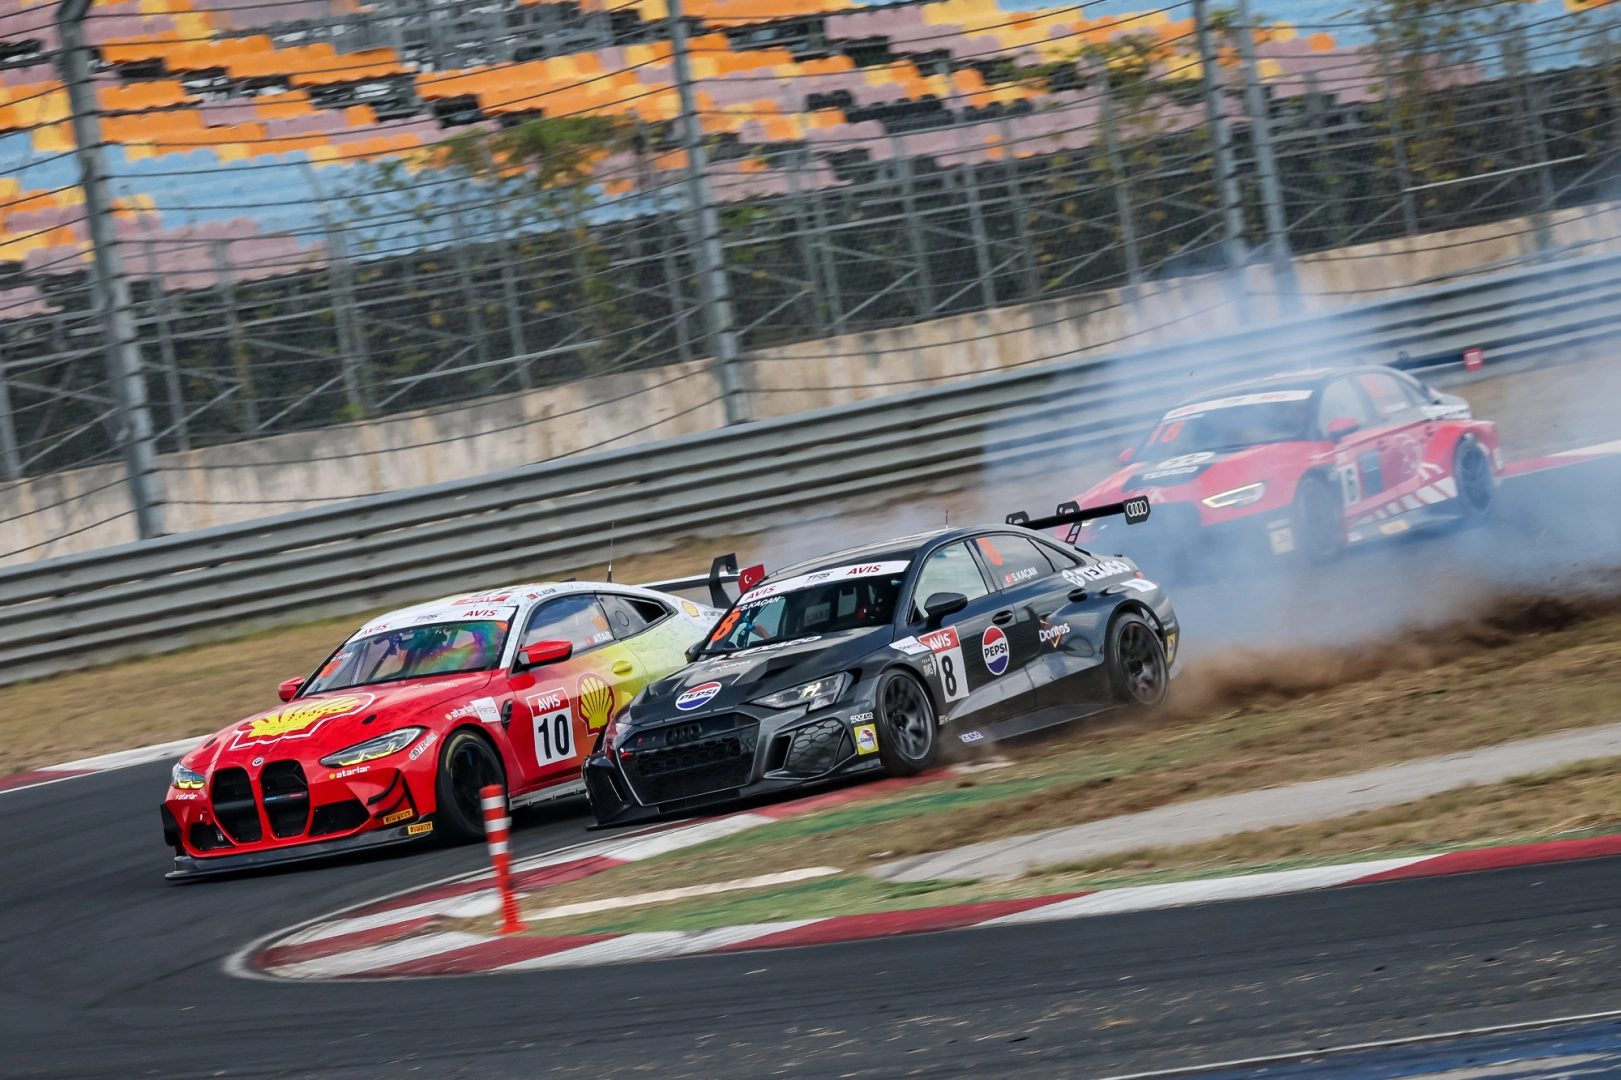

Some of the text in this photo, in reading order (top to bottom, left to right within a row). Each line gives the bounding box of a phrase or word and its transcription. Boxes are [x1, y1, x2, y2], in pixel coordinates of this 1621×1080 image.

[1146, 420, 1186, 448] 16
[978, 537, 1003, 566] 8
[846, 565, 880, 576] AVIS
[1078, 560, 1131, 582] TEXACO
[745, 585, 777, 600] AVIS
[463, 609, 498, 617] AVIS
[358, 623, 390, 637] AVIS
[711, 612, 741, 643] 8
[1038, 621, 1070, 642] Doritos
[593, 630, 613, 644] ATAR
[929, 632, 951, 650] AVIS
[984, 642, 1008, 659] PEPSI
[941, 655, 957, 698] 8
[537, 693, 561, 713] AVIS
[679, 688, 718, 701] PEPSI
[850, 712, 874, 724] sparco
[538, 714, 570, 760] 10
[336, 765, 371, 779] atarlar
